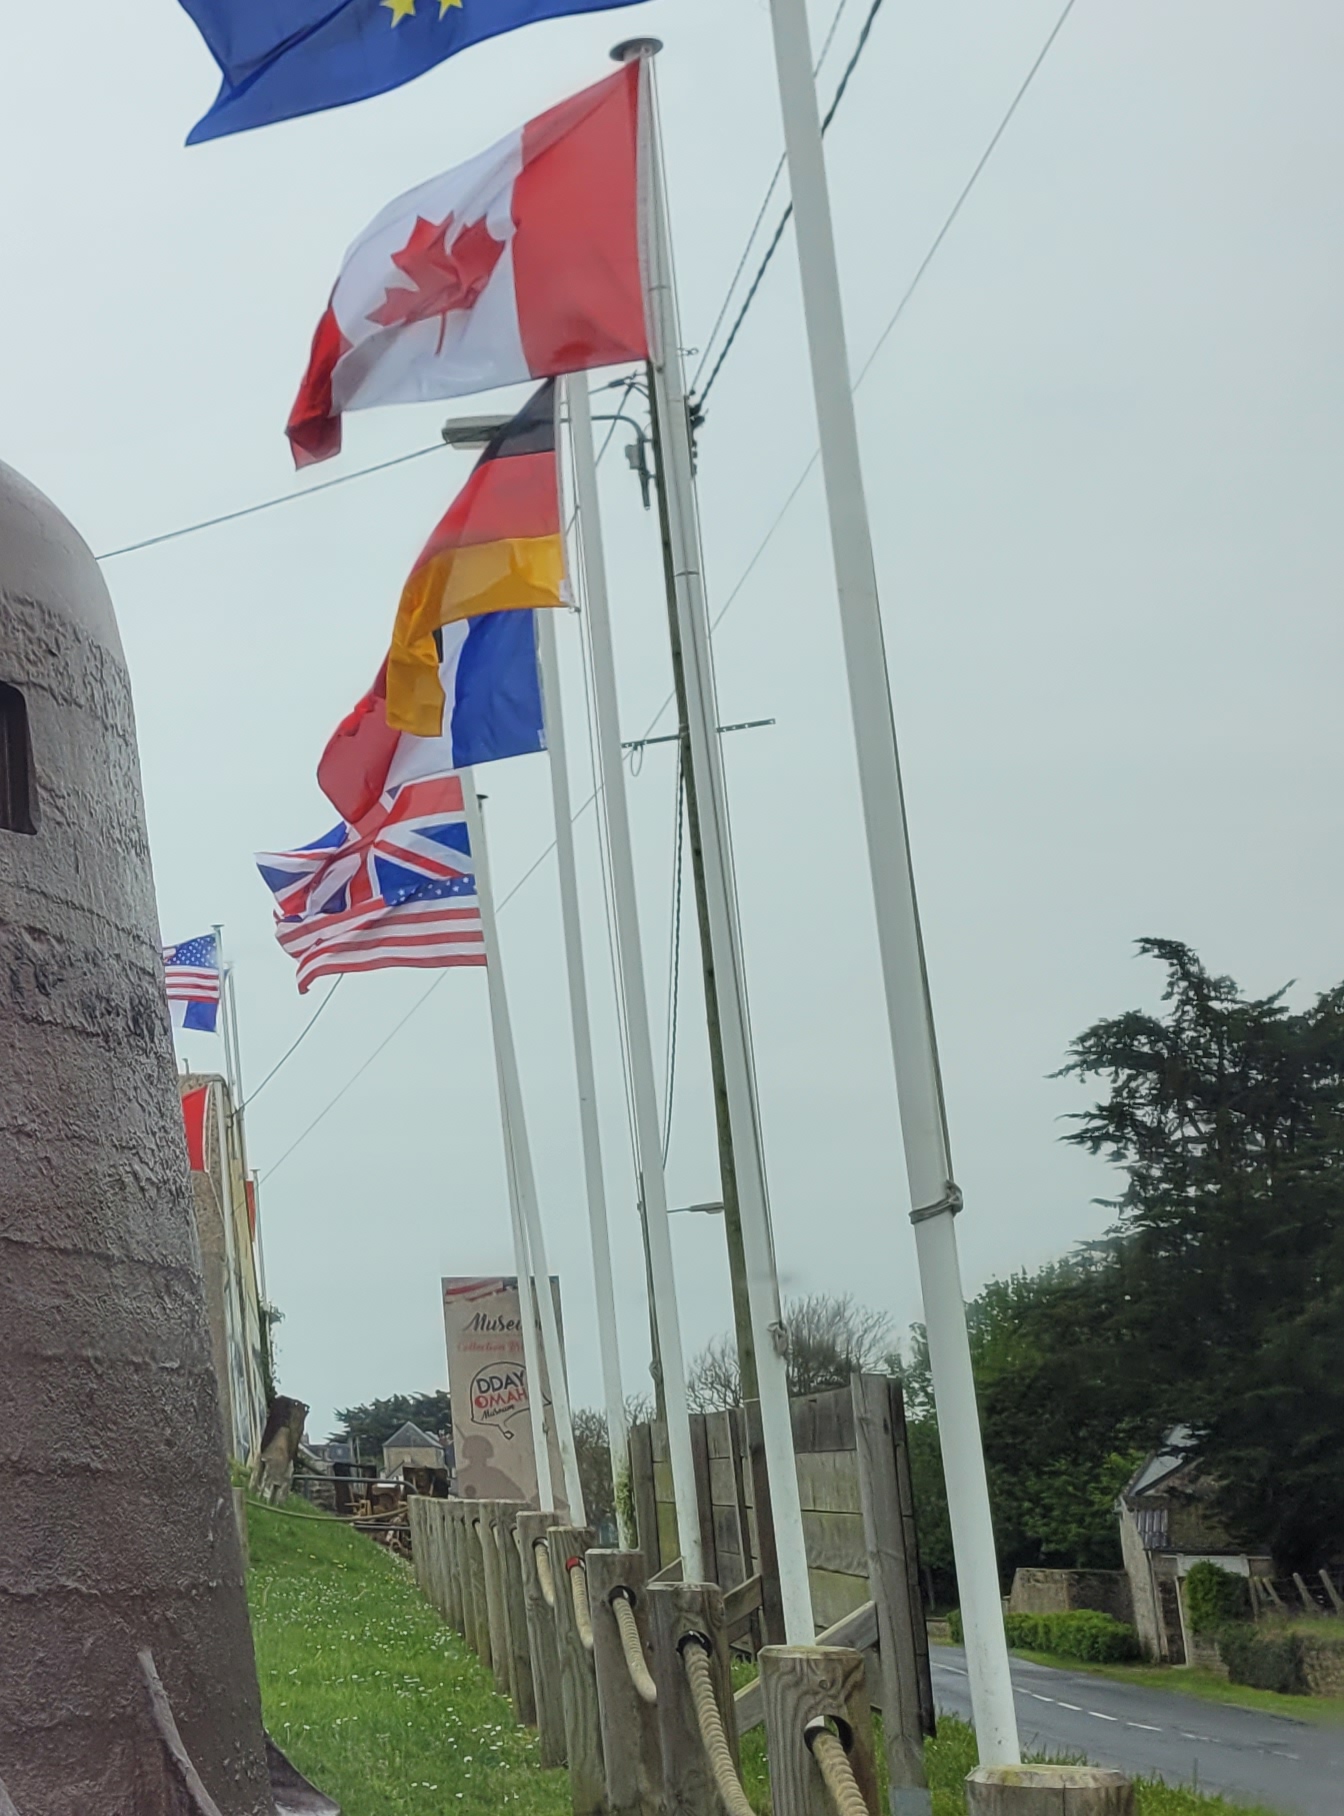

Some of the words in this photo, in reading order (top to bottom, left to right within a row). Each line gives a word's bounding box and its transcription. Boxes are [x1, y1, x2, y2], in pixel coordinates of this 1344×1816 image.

[476, 1369, 525, 1394] DDAY
[474, 1387, 529, 1409] OMAH
[481, 1403, 515, 1421] Museum
